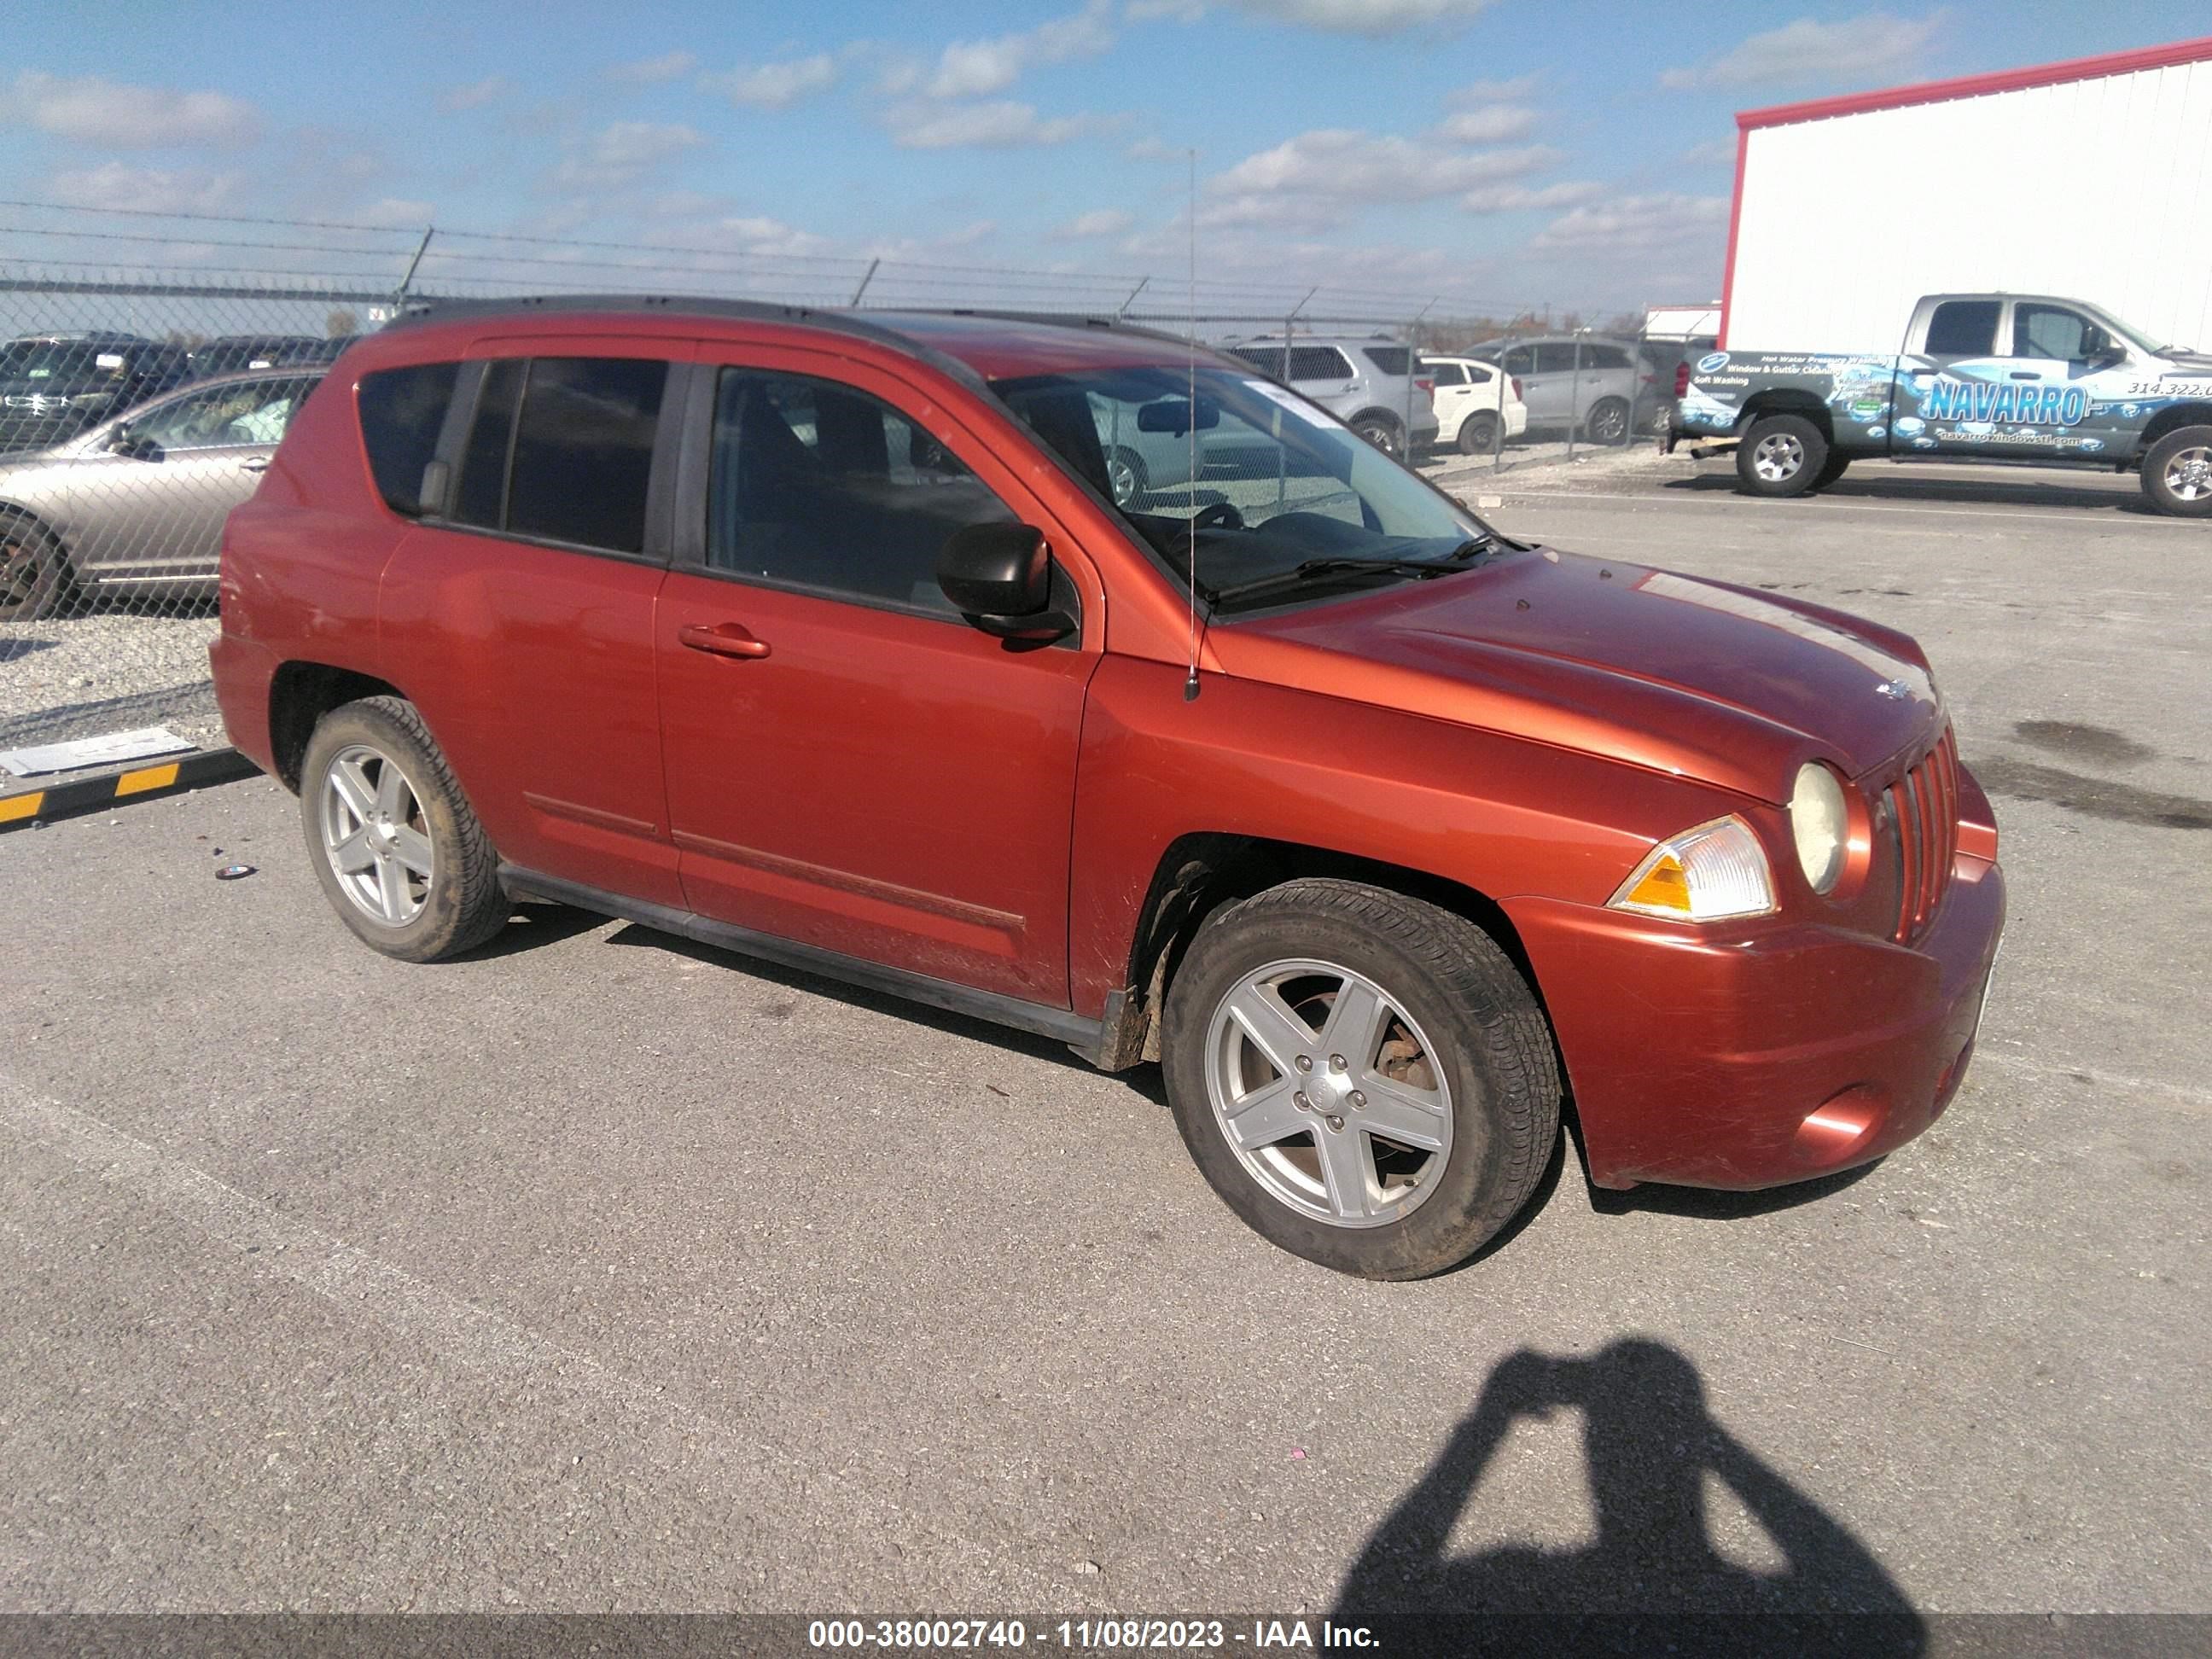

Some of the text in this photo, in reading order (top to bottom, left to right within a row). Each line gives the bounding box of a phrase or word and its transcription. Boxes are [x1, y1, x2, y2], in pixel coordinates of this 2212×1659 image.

[1780, 355, 1806, 364] Water
[1807, 356, 1847, 365] Pressure
[1848, 356, 1889, 368] Washing
[1727, 364, 1761, 374] Window
[1773, 365, 1801, 374] Gutter
[1802, 367, 1842, 377] Cleaning
[1693, 375, 1749, 387] Soft Washing
[1927, 381, 2088, 426] NAVARRO
[1940, 431, 2082, 446] navarrowindowstl.com
